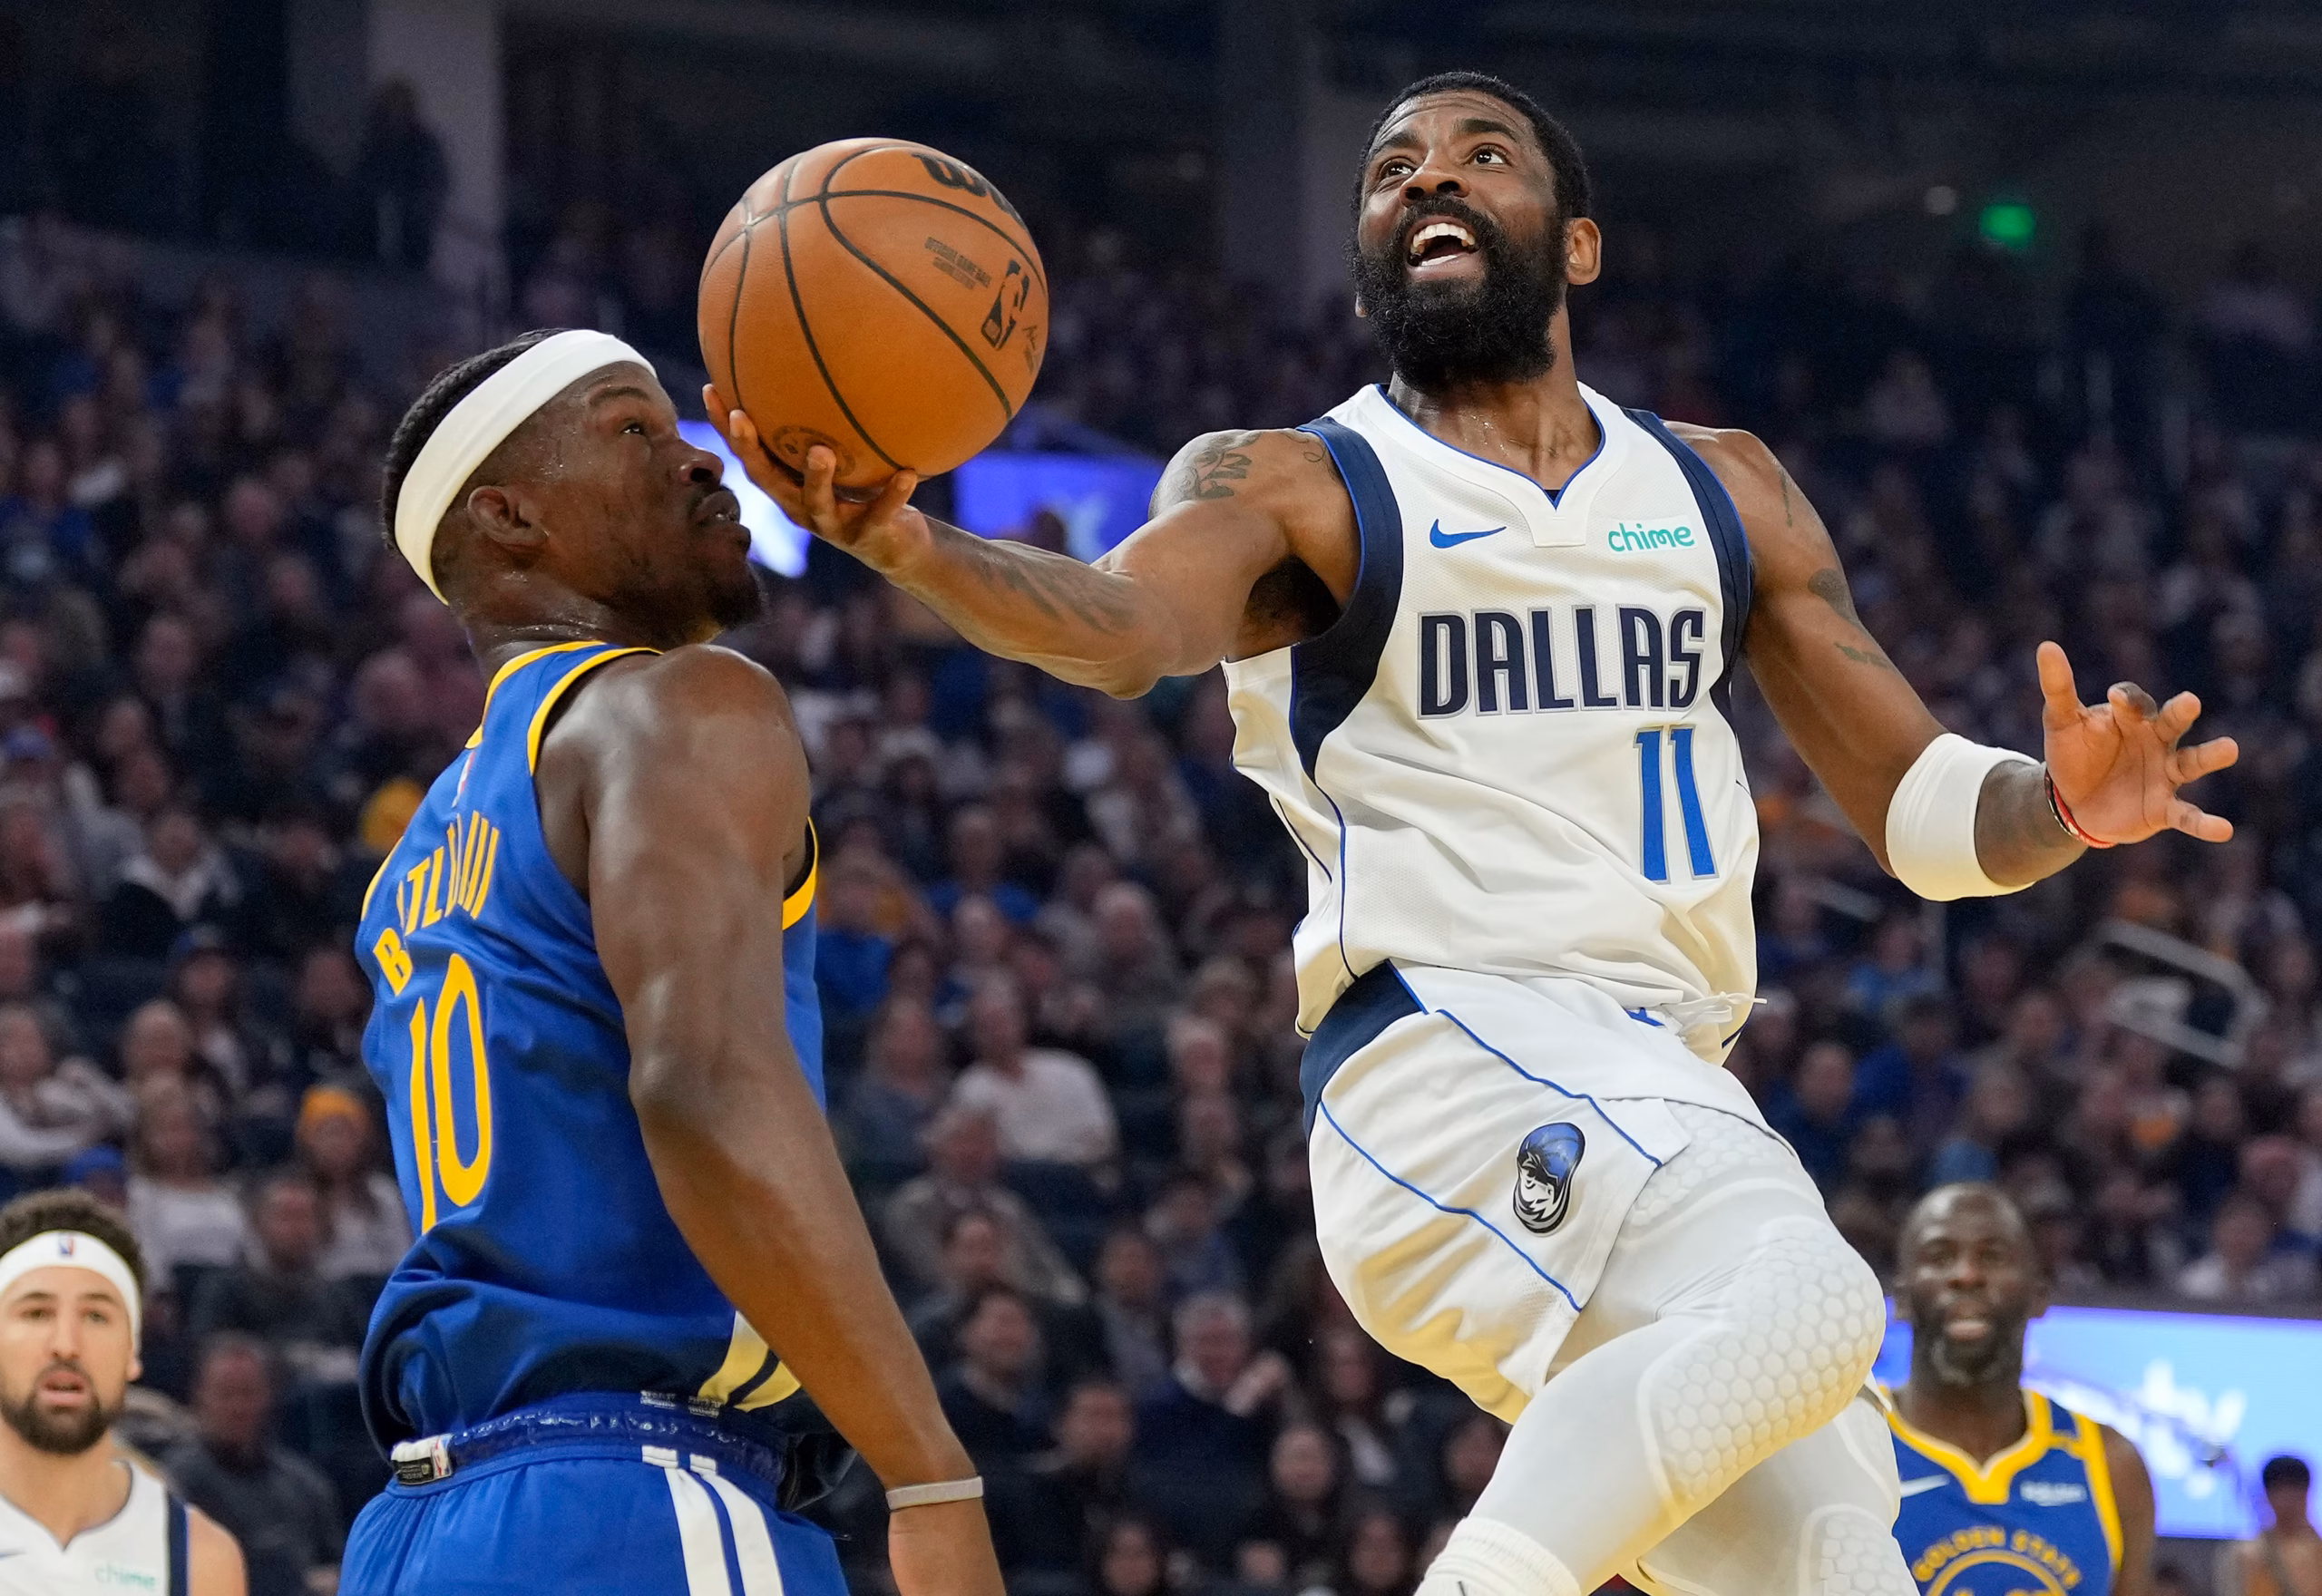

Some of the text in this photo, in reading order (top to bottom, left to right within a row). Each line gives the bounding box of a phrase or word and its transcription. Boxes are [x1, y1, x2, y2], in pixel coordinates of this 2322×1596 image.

[1608, 523, 1694, 552] chime
[1417, 603, 1707, 719] DALLAS
[1633, 725, 1720, 885] 11
[409, 952, 493, 1236] 10
